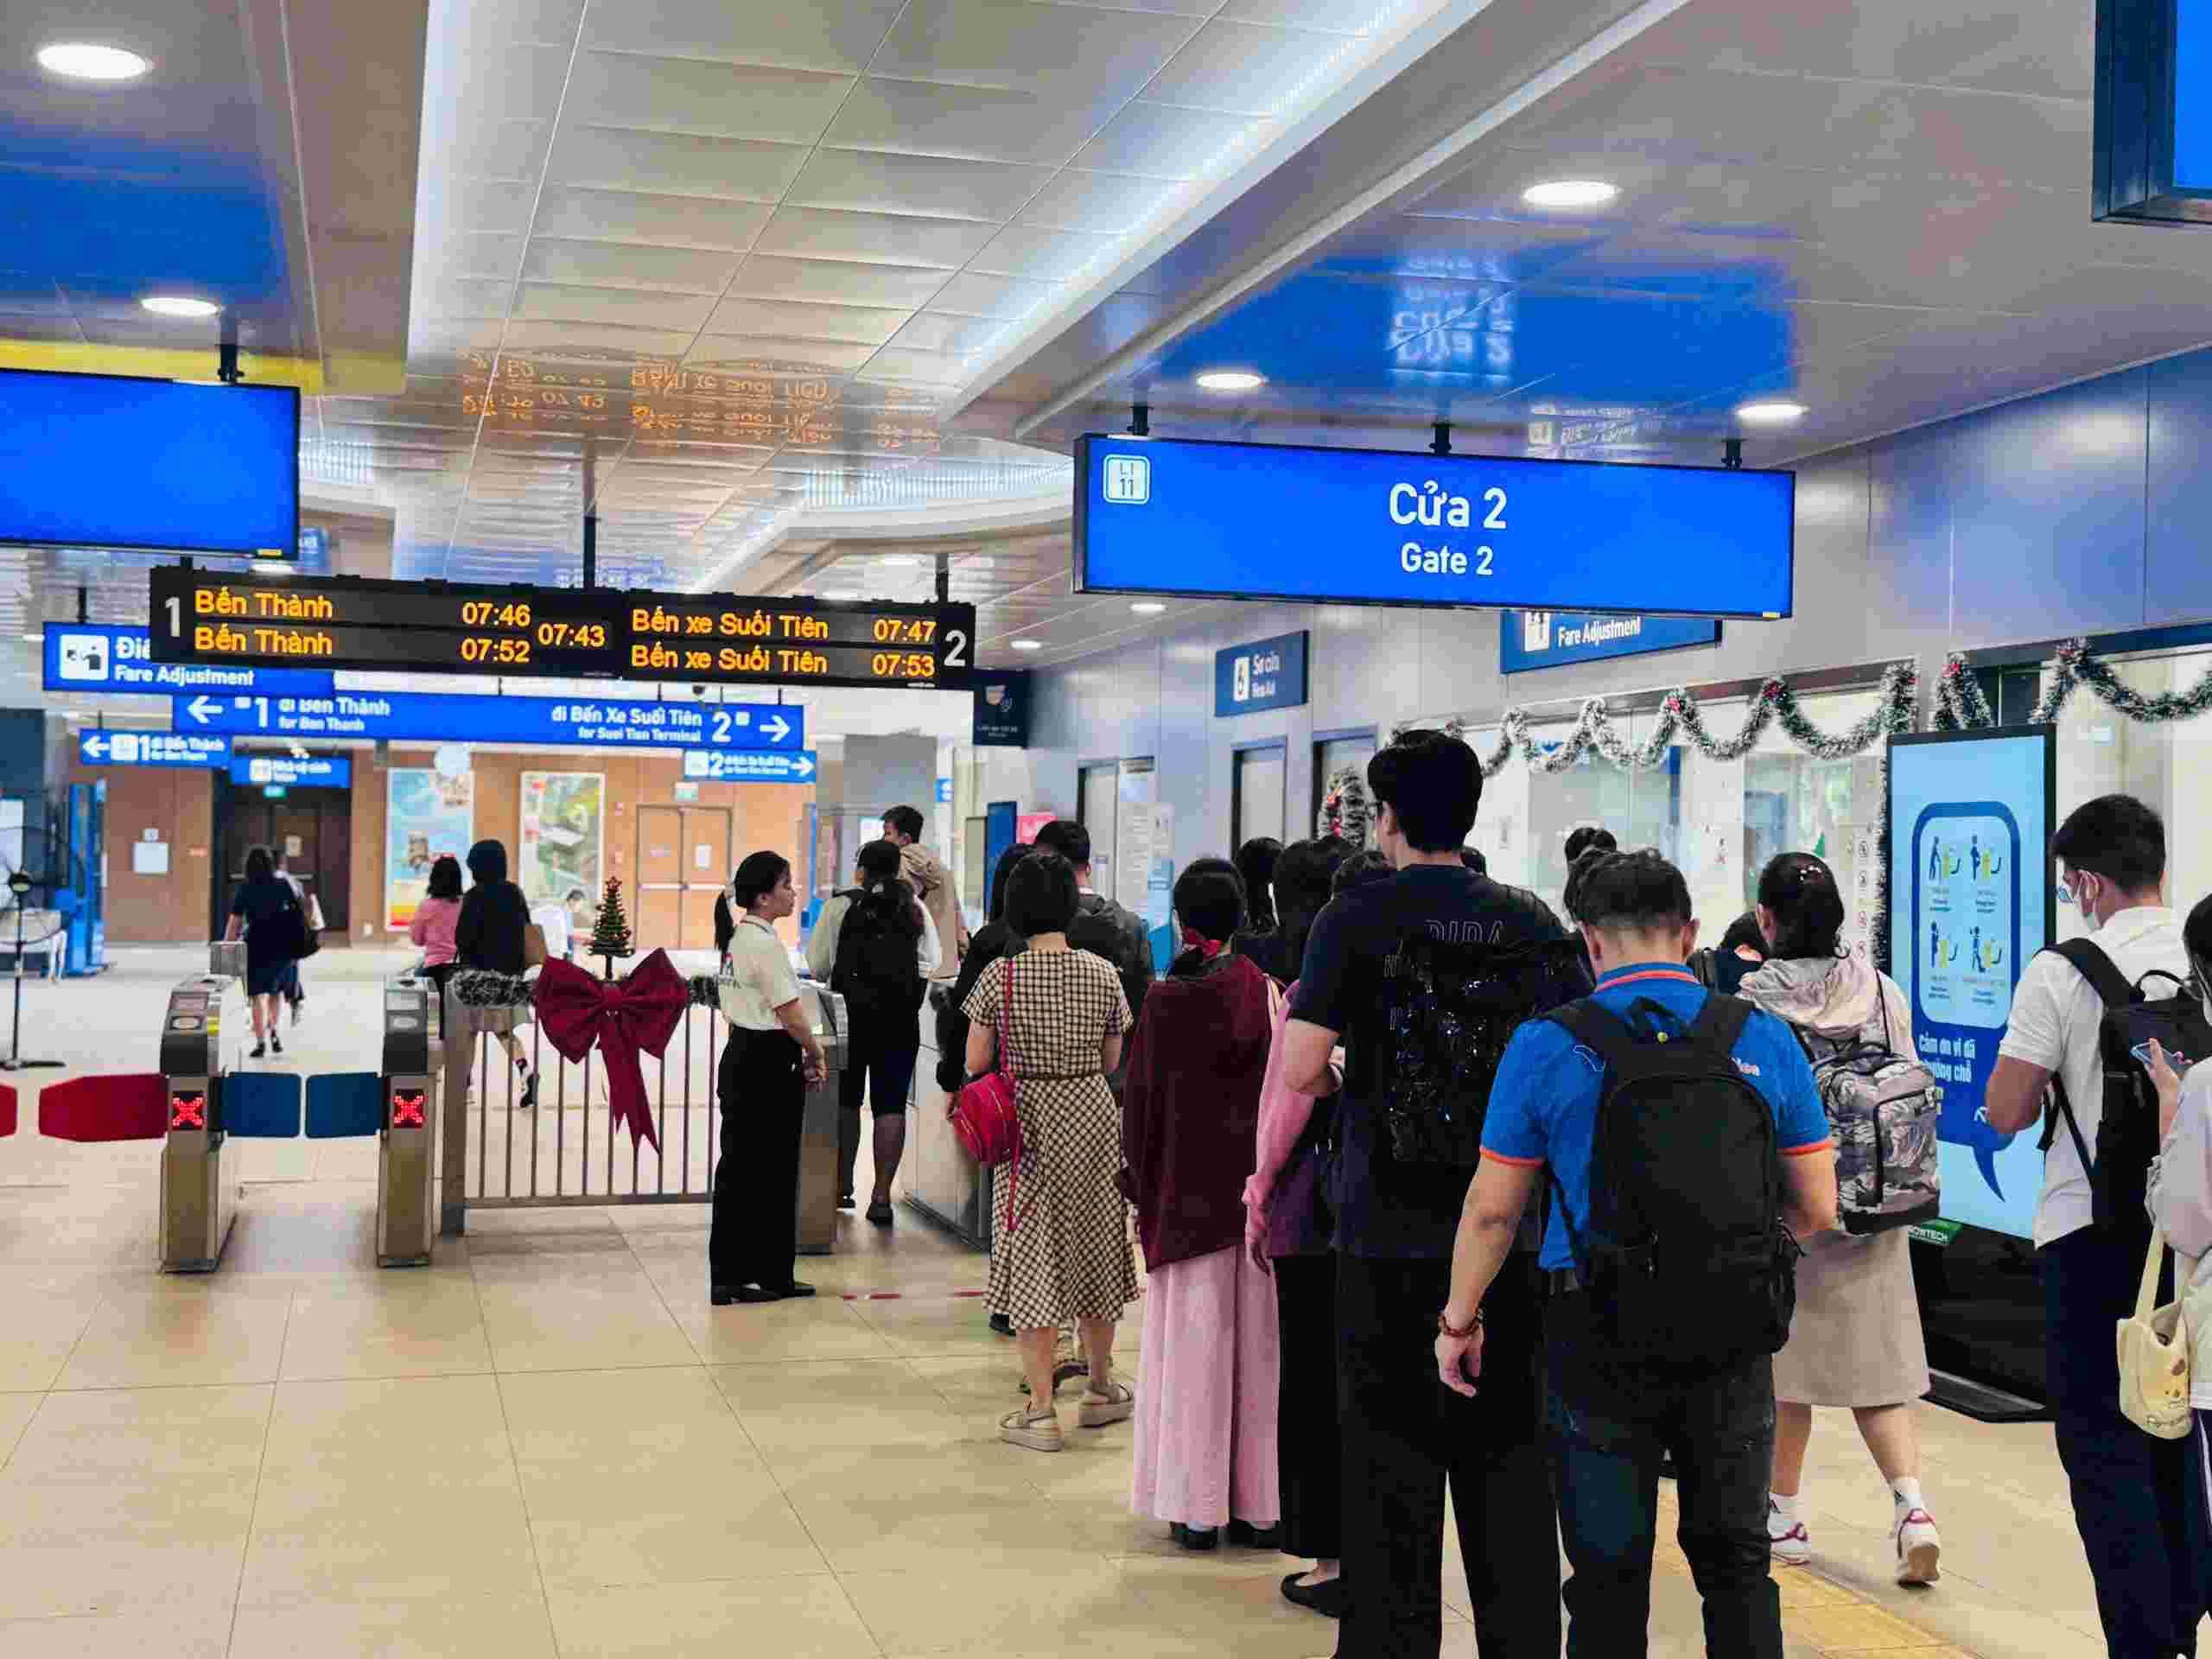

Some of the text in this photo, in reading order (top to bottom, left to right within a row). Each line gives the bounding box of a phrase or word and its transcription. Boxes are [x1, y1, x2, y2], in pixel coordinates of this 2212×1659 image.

[1119, 478, 1135, 497] 11
[1389, 480, 1508, 529] Cửa 2
[1402, 542, 1493, 575] Gate 2
[165, 597, 181, 638] 1
[194, 587, 333, 619] Bến Thành
[462, 602, 531, 626] 07:46
[538, 623, 606, 647] 07:43
[632, 606, 829, 639] Bến xe Suối Tiên
[874, 619, 936, 642] 07:47
[1558, 614, 1641, 647] Fare Adjustment
[194, 623, 333, 655] Bến Thành
[461, 638, 531, 663] 07:52
[944, 630, 967, 667] 2
[631, 642, 827, 674] Bến xe Suối Tiên
[872, 653, 935, 677] 07:53
[114, 664, 255, 687] Fare Adjustment
[255, 696, 268, 728] 1
[606, 707, 626, 724] Xe
[669, 708, 702, 727] Tiên
[711, 711, 732, 742] 2
[652, 728, 701, 742] Terminal
